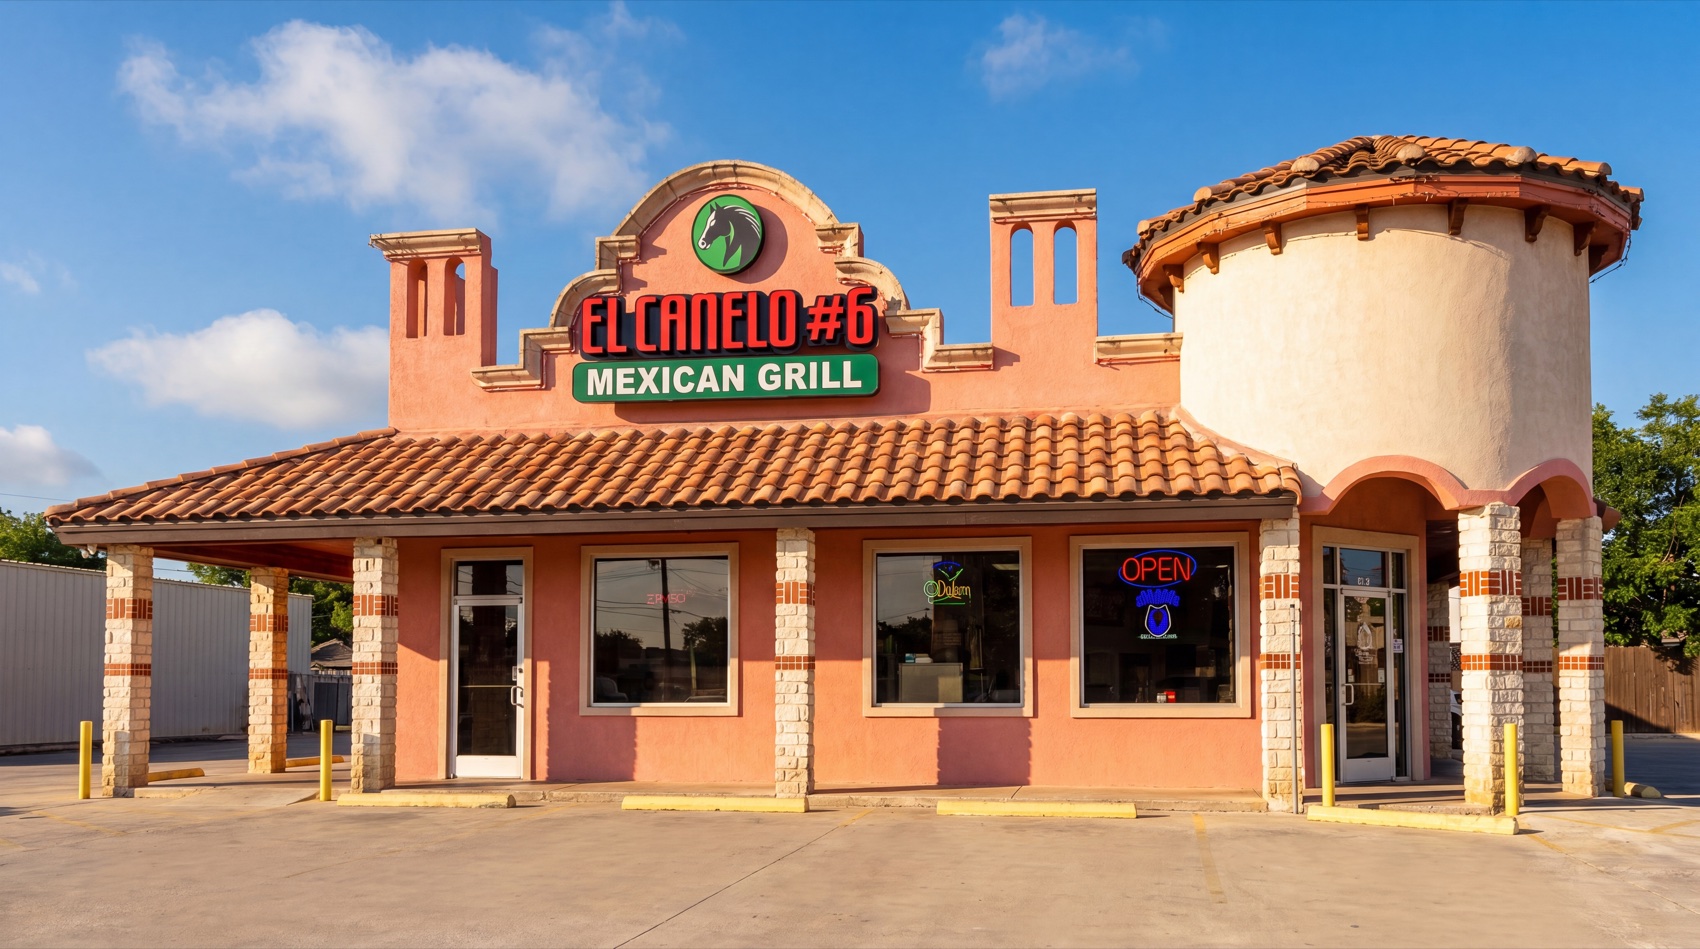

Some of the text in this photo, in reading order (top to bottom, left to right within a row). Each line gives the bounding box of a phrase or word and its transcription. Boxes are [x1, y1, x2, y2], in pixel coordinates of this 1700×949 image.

[582, 288, 873, 354] EL CANELO #6
[587, 361, 862, 395] MEXICAN GRILL
[1121, 557, 1192, 582] OPEN
